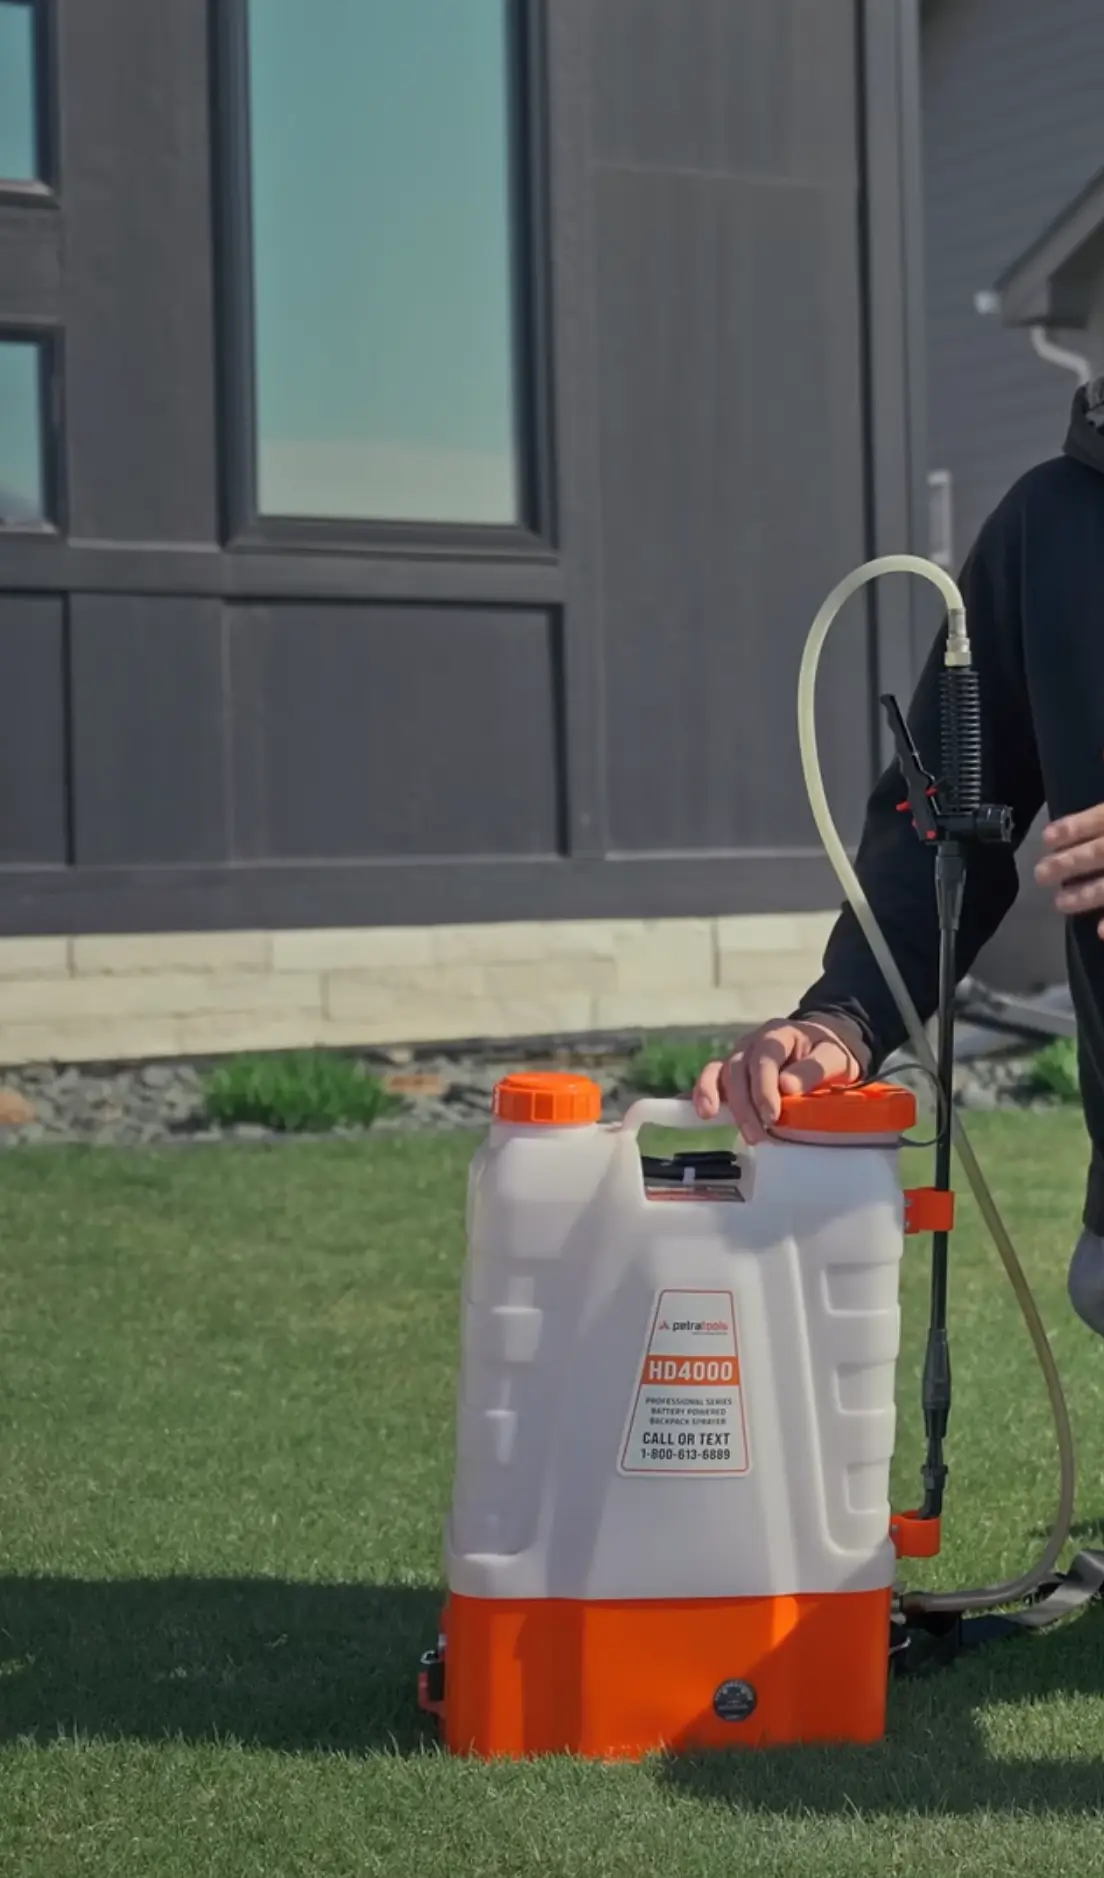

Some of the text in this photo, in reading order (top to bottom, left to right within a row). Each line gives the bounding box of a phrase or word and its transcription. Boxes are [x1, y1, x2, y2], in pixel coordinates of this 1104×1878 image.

[672, 1320, 729, 1333] petratools
[649, 1361, 732, 1381] HD4000
[646, 1397, 703, 1405] PROFESSIONAL
[687, 1408, 726, 1416] POWERED
[650, 1417, 689, 1425] BACKPACK
[643, 1433, 731, 1446] CALL OR TEXT
[641, 1448, 731, 1460] 1-800-613-6889
